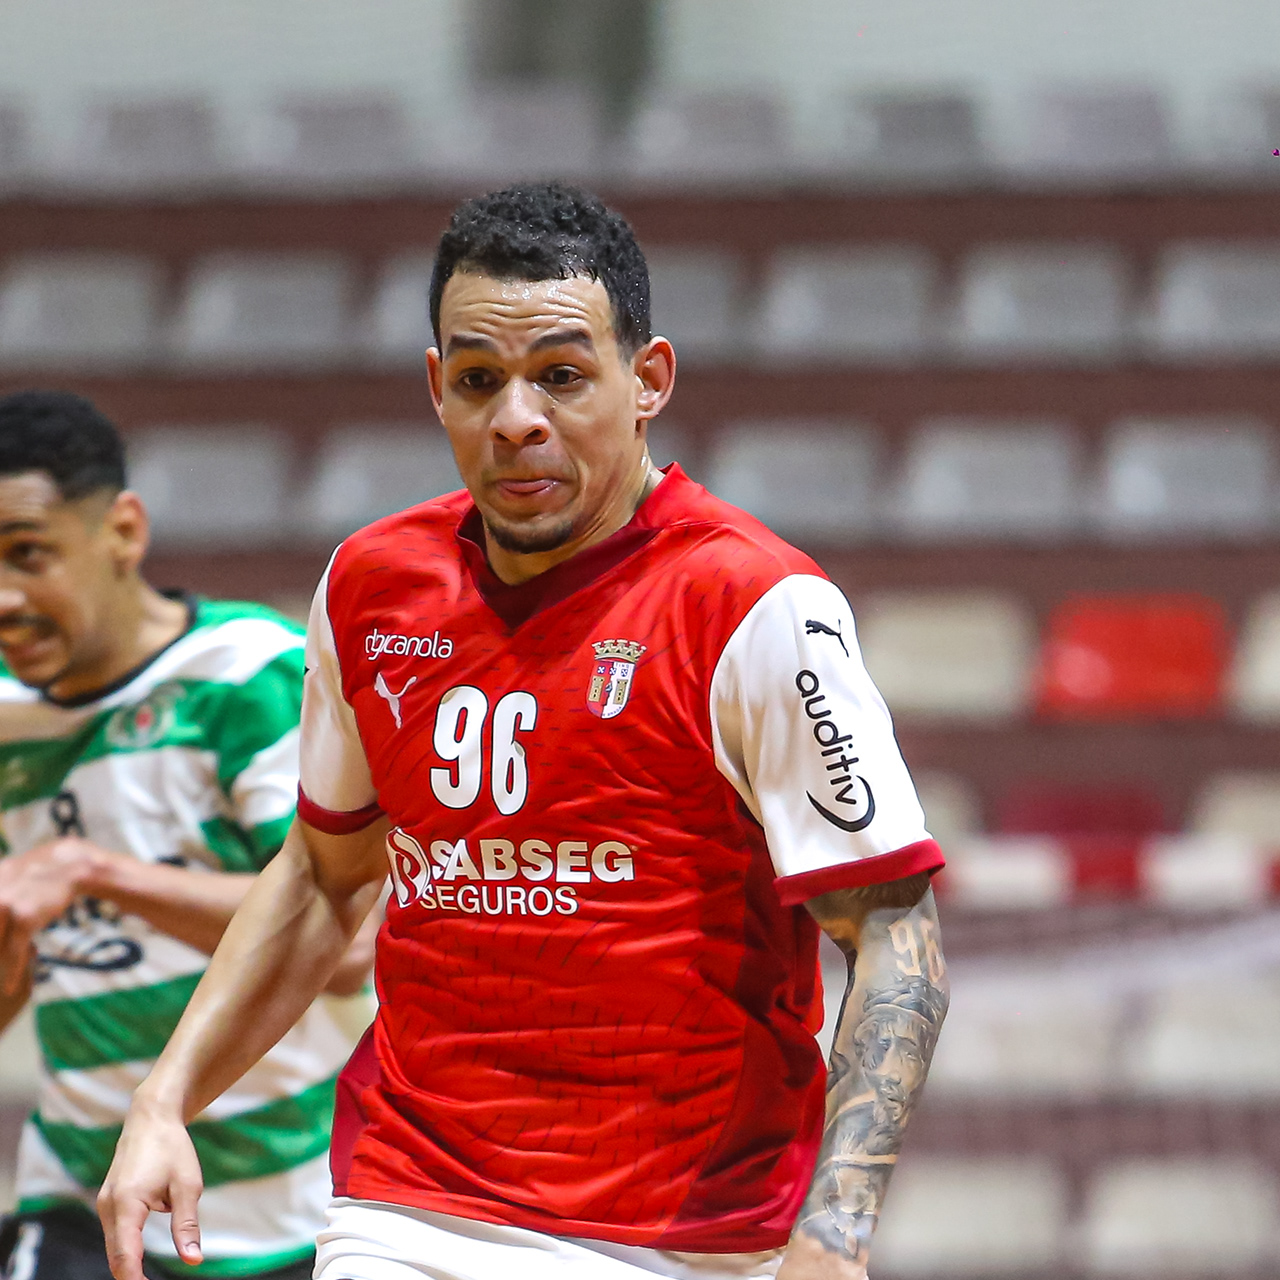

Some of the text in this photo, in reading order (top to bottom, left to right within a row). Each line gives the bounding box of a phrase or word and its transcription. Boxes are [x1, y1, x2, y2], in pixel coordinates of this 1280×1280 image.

[430, 684, 538, 816] 96
[795, 668, 859, 806] auditiv
[420, 884, 578, 916] SEGUROS
[429, 838, 635, 882] SABSEG
